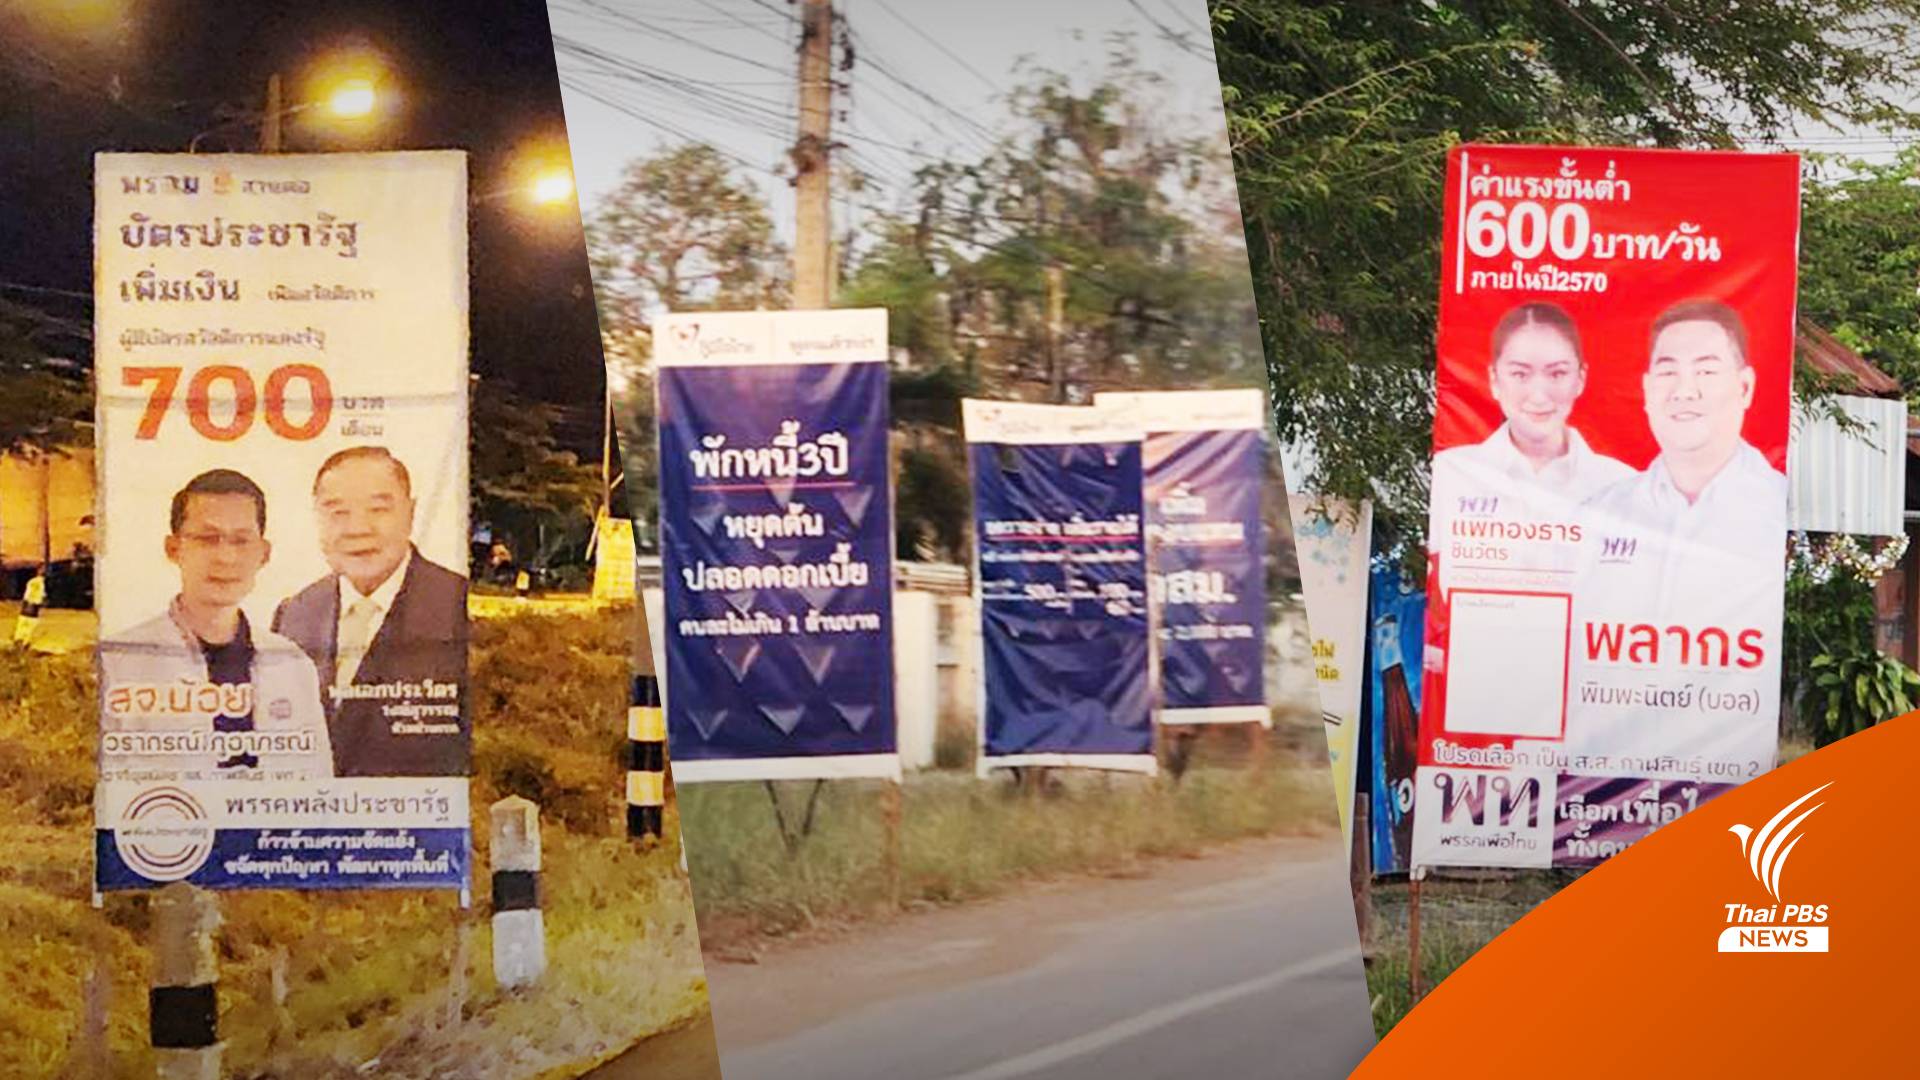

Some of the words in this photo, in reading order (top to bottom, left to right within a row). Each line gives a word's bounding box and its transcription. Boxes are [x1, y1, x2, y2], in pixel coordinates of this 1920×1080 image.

[1470, 157, 1630, 200] ค่าแรงขั้นต่ำ
[120, 212, 358, 258] บัตรประชารัฐ
[1466, 200, 1590, 260] 600
[120, 263, 240, 301] เพิ่มเงิน
[1471, 262, 1608, 292] ภายในปี2570
[122, 363, 333, 441] 700
[341, 396, 385, 410] บาท
[689, 419, 849, 478] พักหนี้3ปี
[723, 502, 824, 549] หยุดต้น
[1452, 519, 1583, 542] แพทองธาร
[682, 542, 868, 591] ปลอดดอกเบี้ย
[788, 615, 799, 634] 1
[1586, 622, 1765, 669] พลากร
[111, 678, 247, 715] สจ.น้อย
[1581, 682, 1693, 708] พิมพะนิตย์
[1698, 686, 1760, 713] (บอล)
[1434, 741, 1529, 766] โปรดเลือก
[1536, 747, 1568, 768] เป็น
[1575, 755, 1613, 771] ส.ส.
[1707, 762, 1741, 777] เขต
[1748, 761, 1759, 777] 2
[226, 789, 449, 822] พรรคพลังประชารัฐ
[1434, 772, 1540, 828] พท
[1440, 832, 1537, 850] พรรคเพื่อไทย
